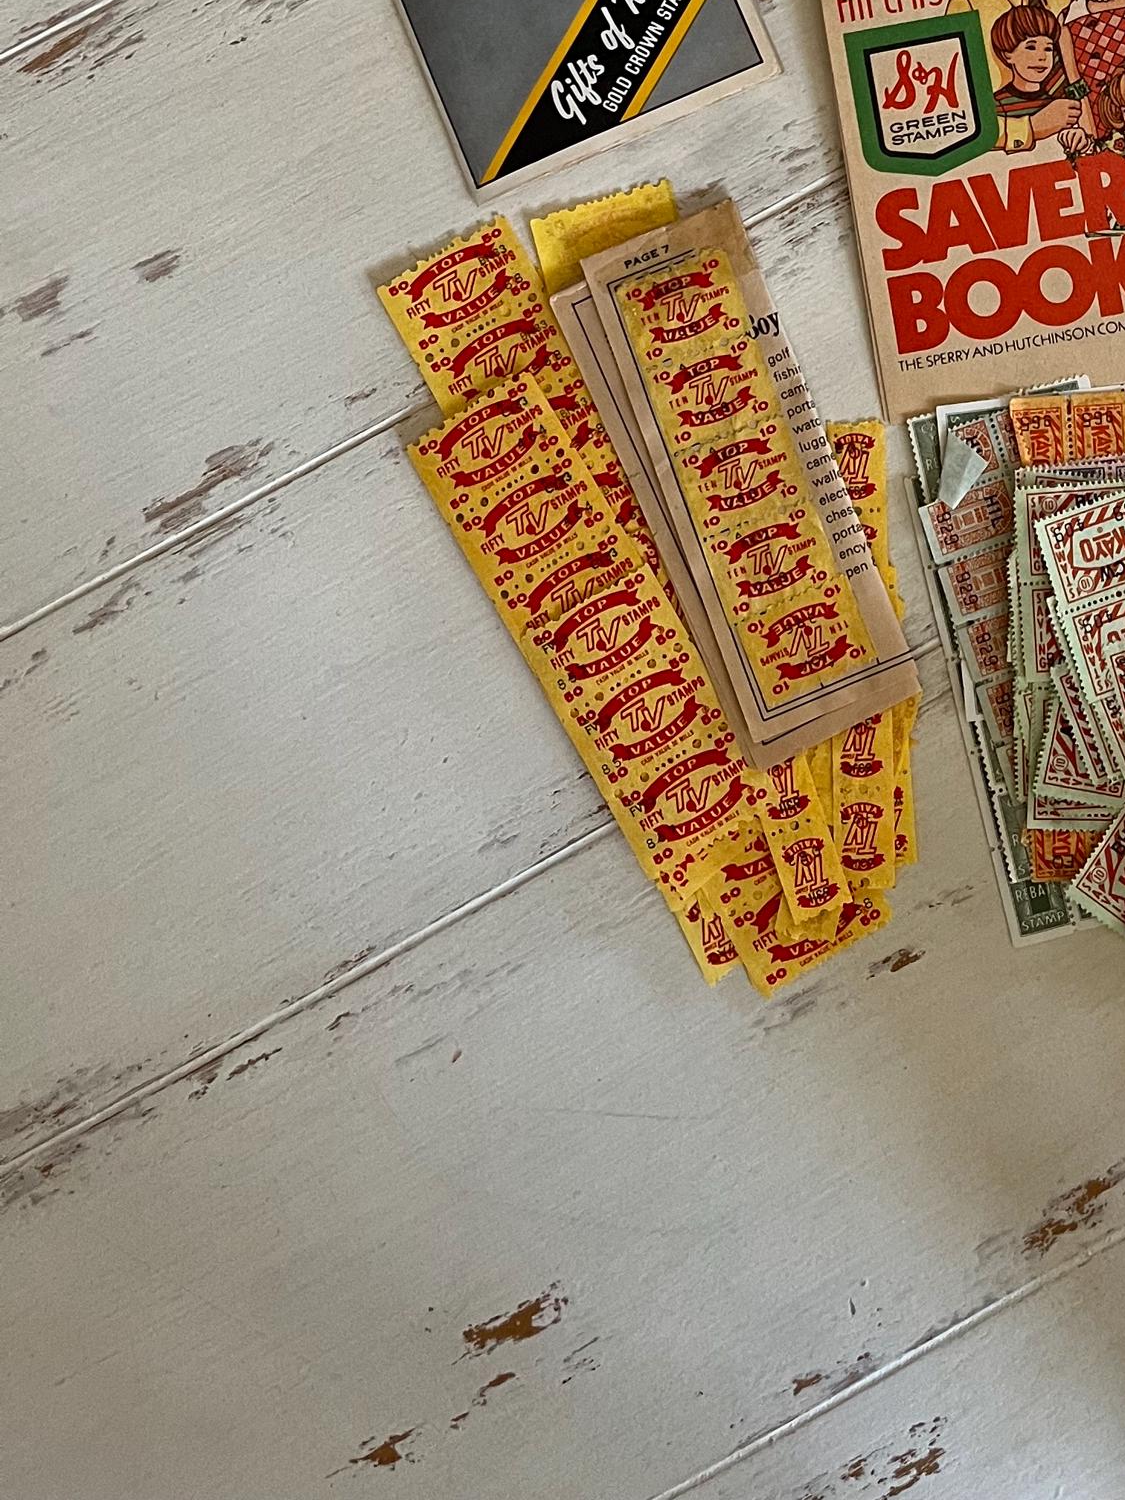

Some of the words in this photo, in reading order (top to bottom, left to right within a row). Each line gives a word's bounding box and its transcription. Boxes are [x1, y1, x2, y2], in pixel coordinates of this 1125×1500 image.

[549, 51, 606, 125] Gifts
[601, 6, 635, 53] of
[602, 73, 633, 114] GOLD
[626, 23, 662, 82] CROWN
[890, 109, 967, 134] GREEN
[891, 122, 969, 147] STAMPS
[481, 229, 502, 244] 50
[430, 251, 465, 276] TOP
[623, 247, 660, 270] PAGE
[661, 244, 671, 256] 7
[389, 281, 409, 297] 50
[433, 268, 478, 302] TV
[478, 251, 517, 278] STAMPS
[511, 280, 531, 297] 50
[406, 298, 432, 321] FIFTY
[442, 286, 500, 325] VALUE
[661, 291, 701, 324] TV
[699, 285, 730, 304] STAMPS
[723, 317, 741, 331] 10
[767, 346, 791, 368] golf
[898, 357, 924, 374] THE
[925, 349, 970, 369] SPERRY
[971, 343, 1004, 361] AND
[1003, 326, 1096, 355] HUTCHINSON
[458, 408, 492, 433] TOP
[461, 424, 506, 459] TV
[505, 404, 544, 434] STAMPS
[436, 456, 462, 479] FIFTY
[471, 443, 528, 483] VALUE
[682, 455, 700, 469] 10
[718, 458, 758, 491] TV
[757, 452, 788, 470] STAMPS
[846, 562, 869, 582] pen
[572, 599, 607, 624] TOP
[576, 616, 622, 652] TV
[622, 596, 661, 627] STAMPS
[550, 649, 576, 672] FIFTY
[585, 637, 642, 675] VALUE
[1021, 910, 1066, 932] STAMP
